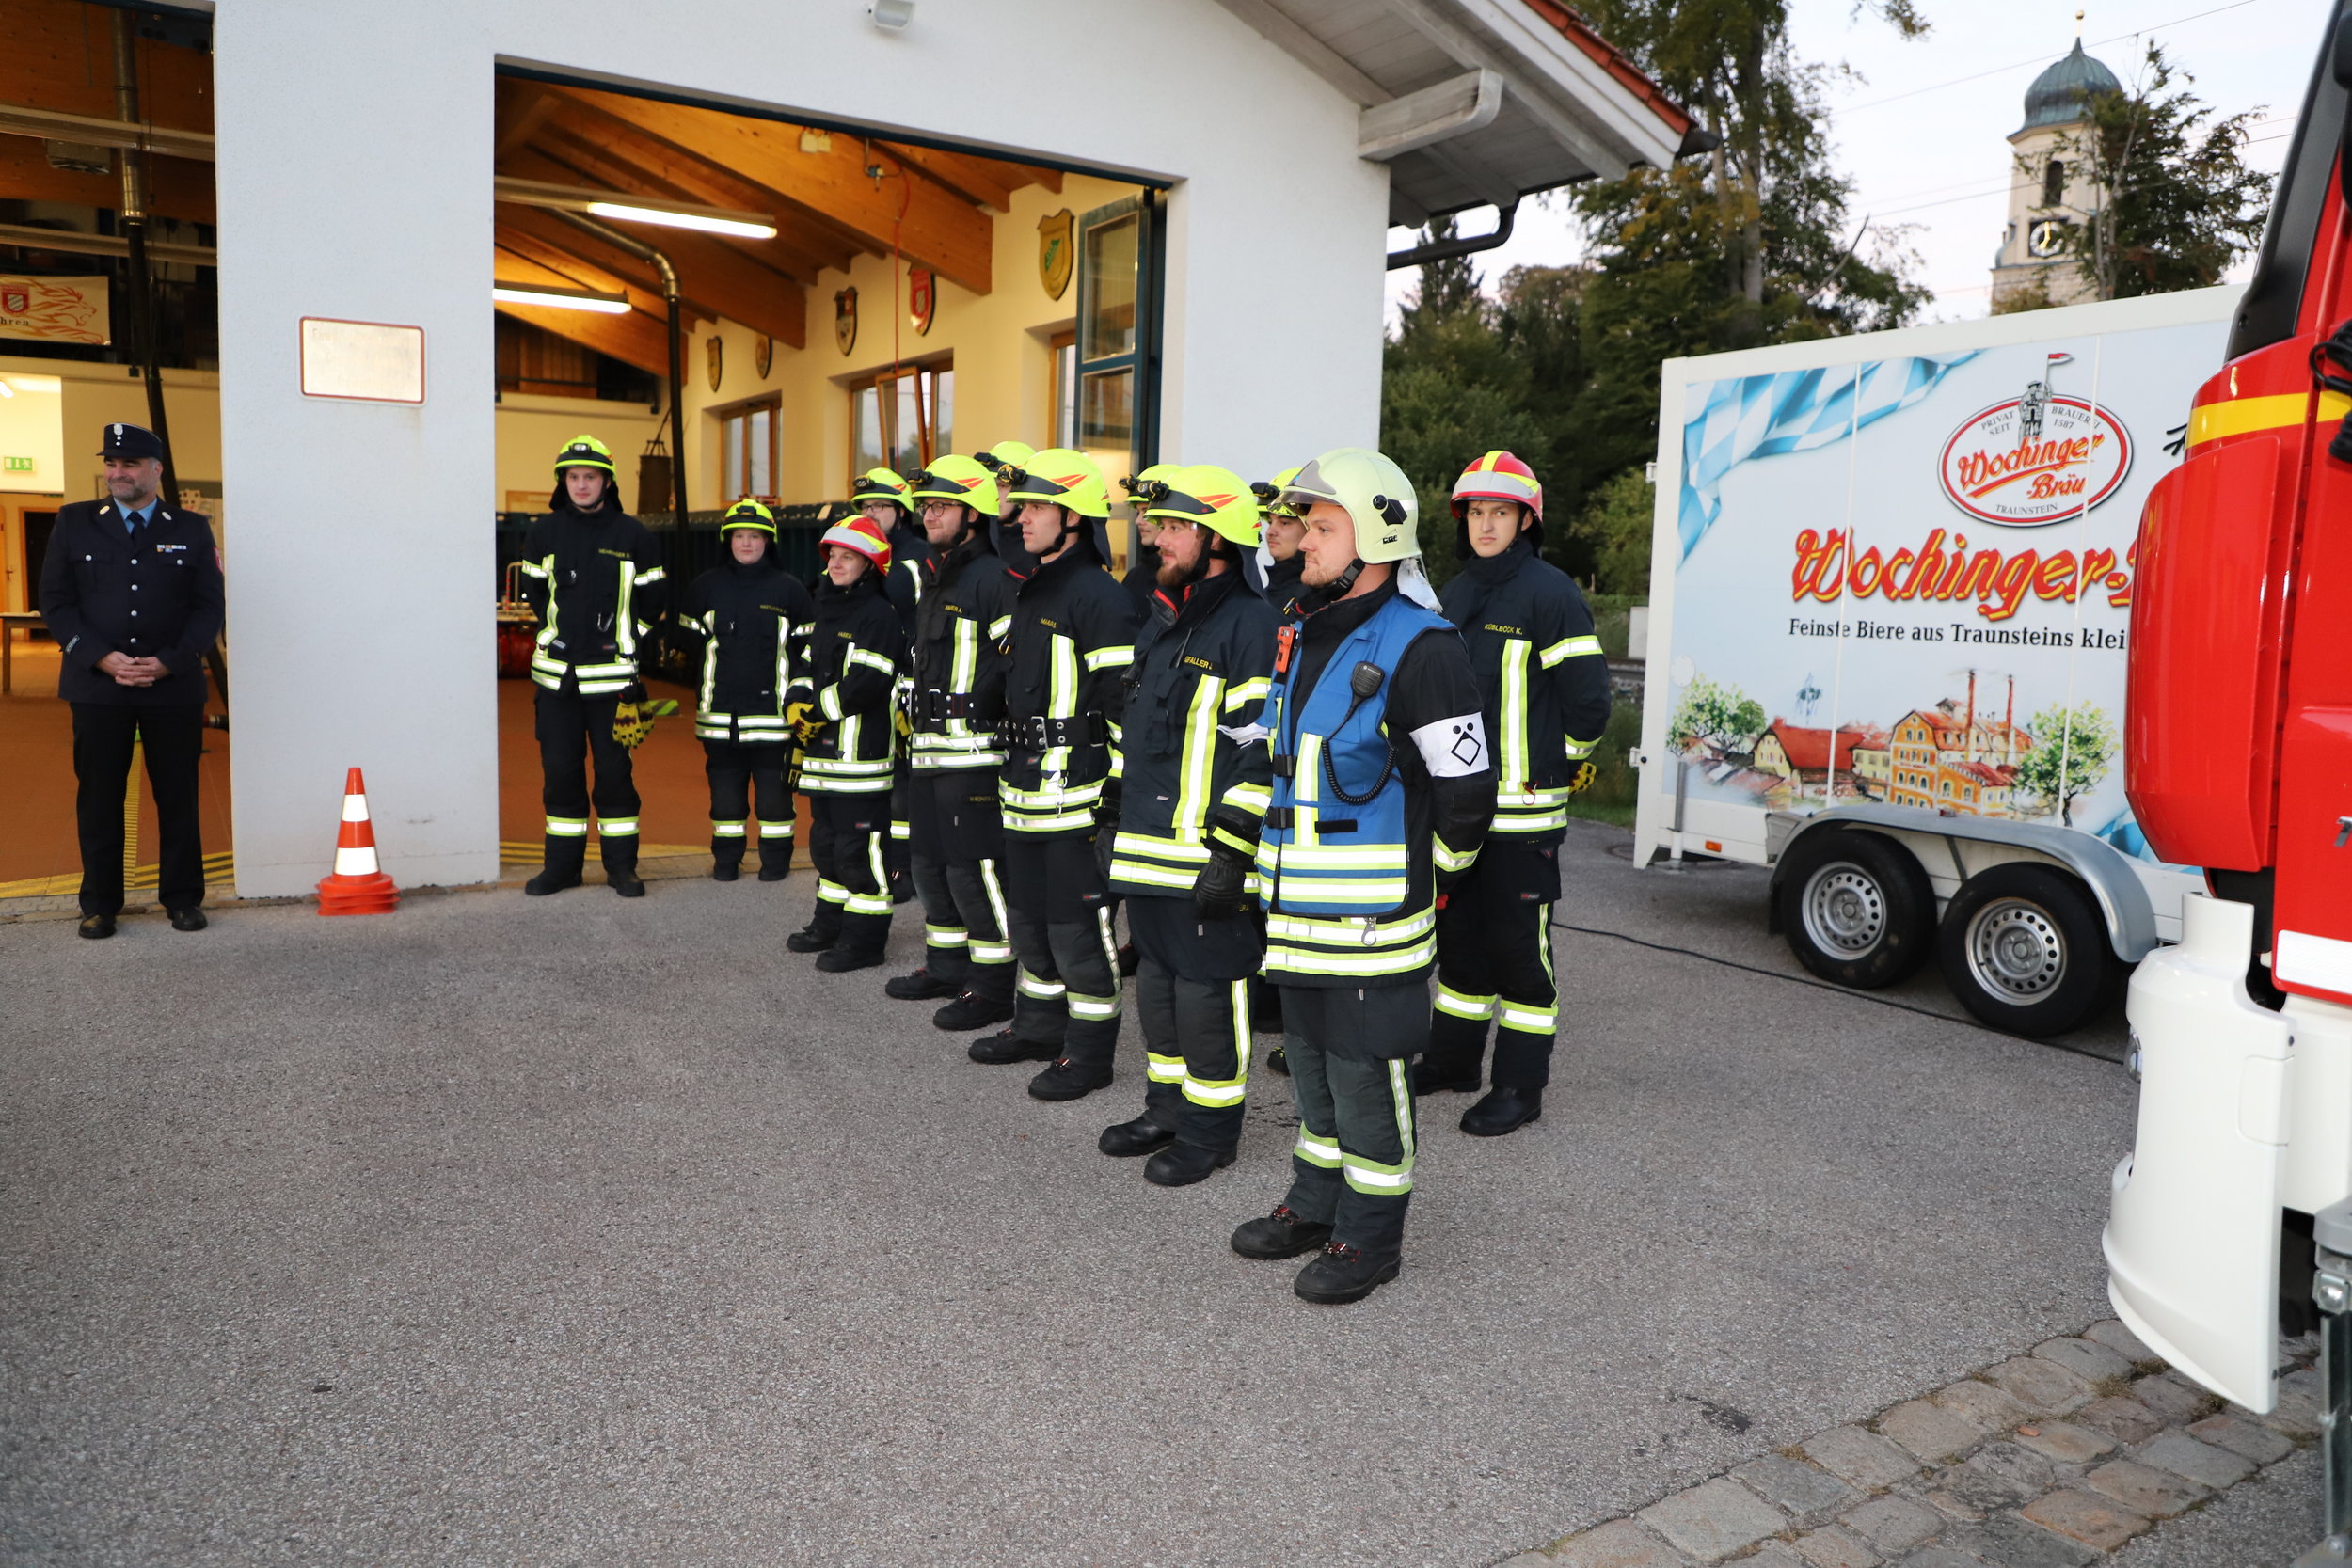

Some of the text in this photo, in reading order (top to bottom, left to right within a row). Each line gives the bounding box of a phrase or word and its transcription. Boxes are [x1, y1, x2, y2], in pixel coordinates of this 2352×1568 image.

[1981, 411, 2015, 430] PRIVAT
[1989, 419, 2074, 436] SEIT 1587
[1958, 433, 2105, 490] Wochinger
[1995, 503, 2058, 515] TRAUNSTEIN
[1788, 618, 1851, 638] Feinste
[1856, 620, 1905, 641] Biere
[1911, 625, 1945, 641] aus
[1950, 624, 2074, 647] Traunsteins
